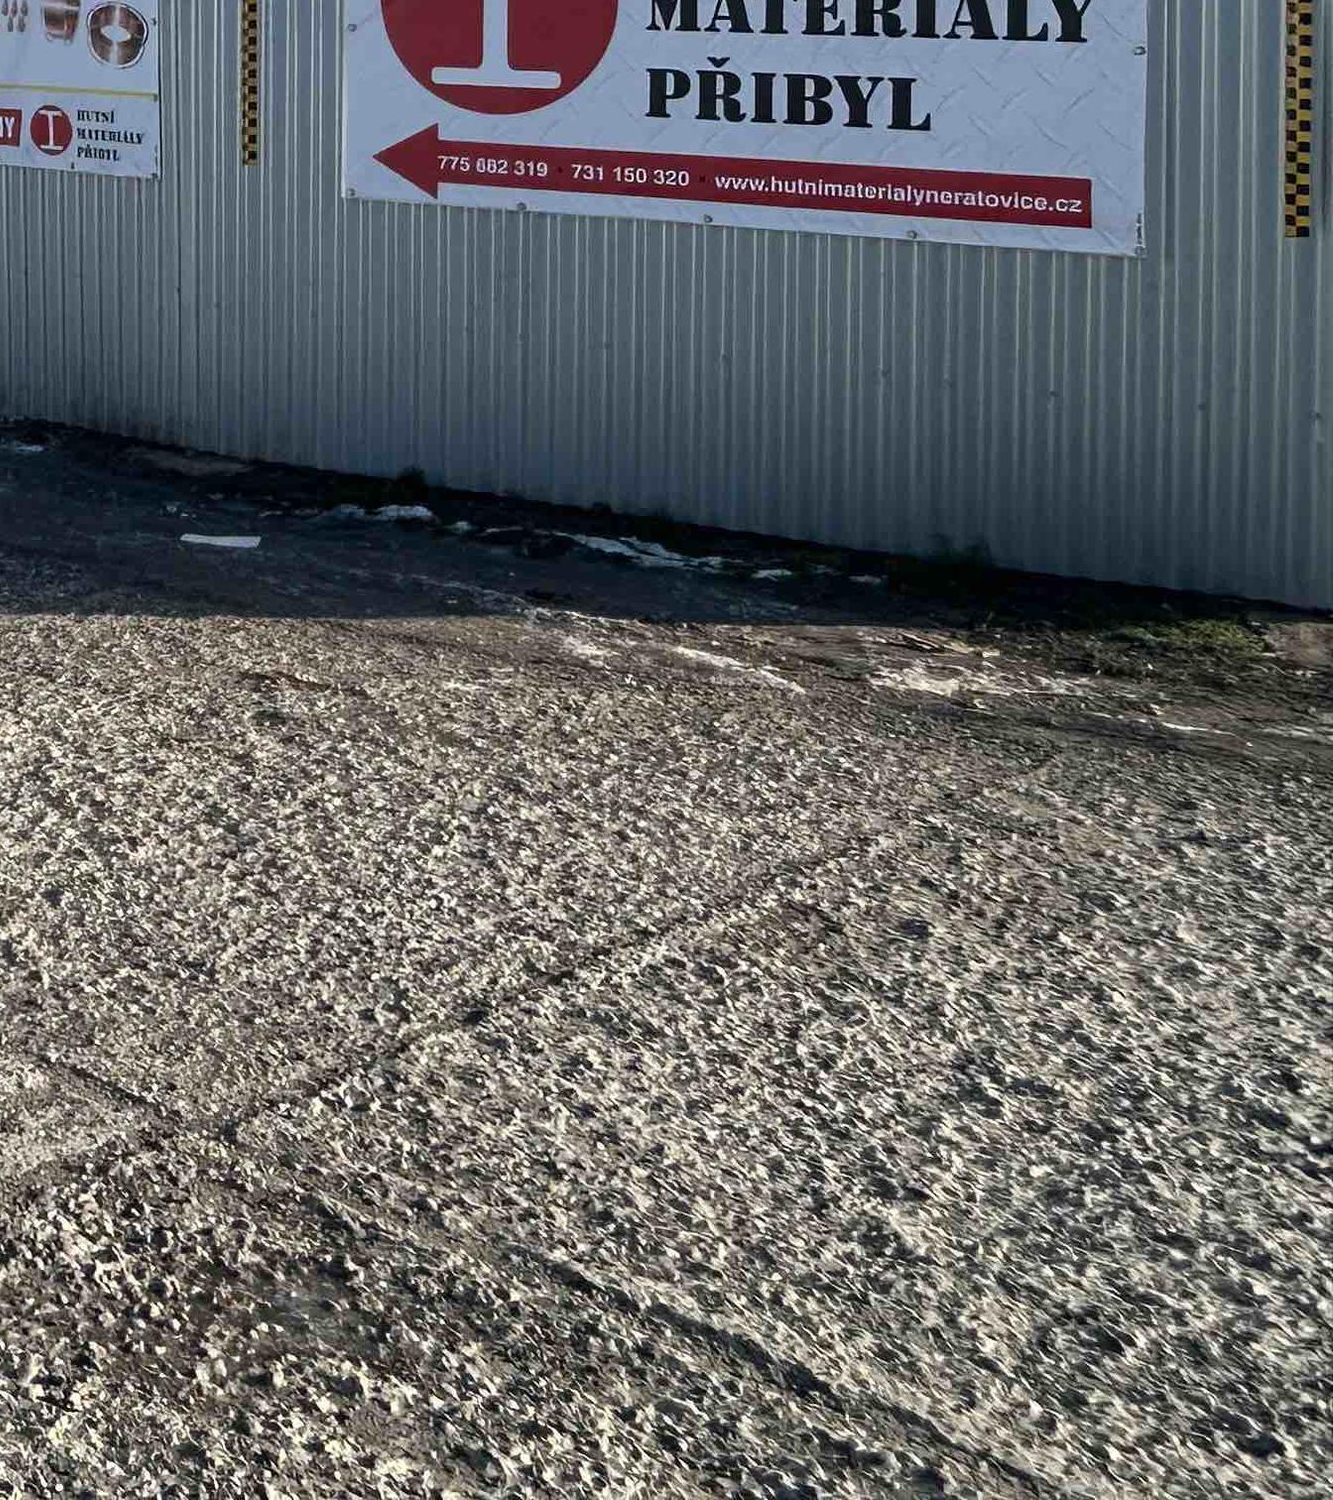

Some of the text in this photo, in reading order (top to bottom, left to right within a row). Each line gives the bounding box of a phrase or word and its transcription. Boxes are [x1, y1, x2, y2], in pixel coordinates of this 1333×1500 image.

[645, 57, 932, 131] PŘIBYL
[437, 155, 471, 172] 775
[513, 160, 549, 178] 319
[571, 164, 605, 181] 731
[612, 166, 647, 184] 150
[653, 169, 690, 187] 320
[713, 173, 1083, 214] www.hutnimaterialyneratovice.cz
